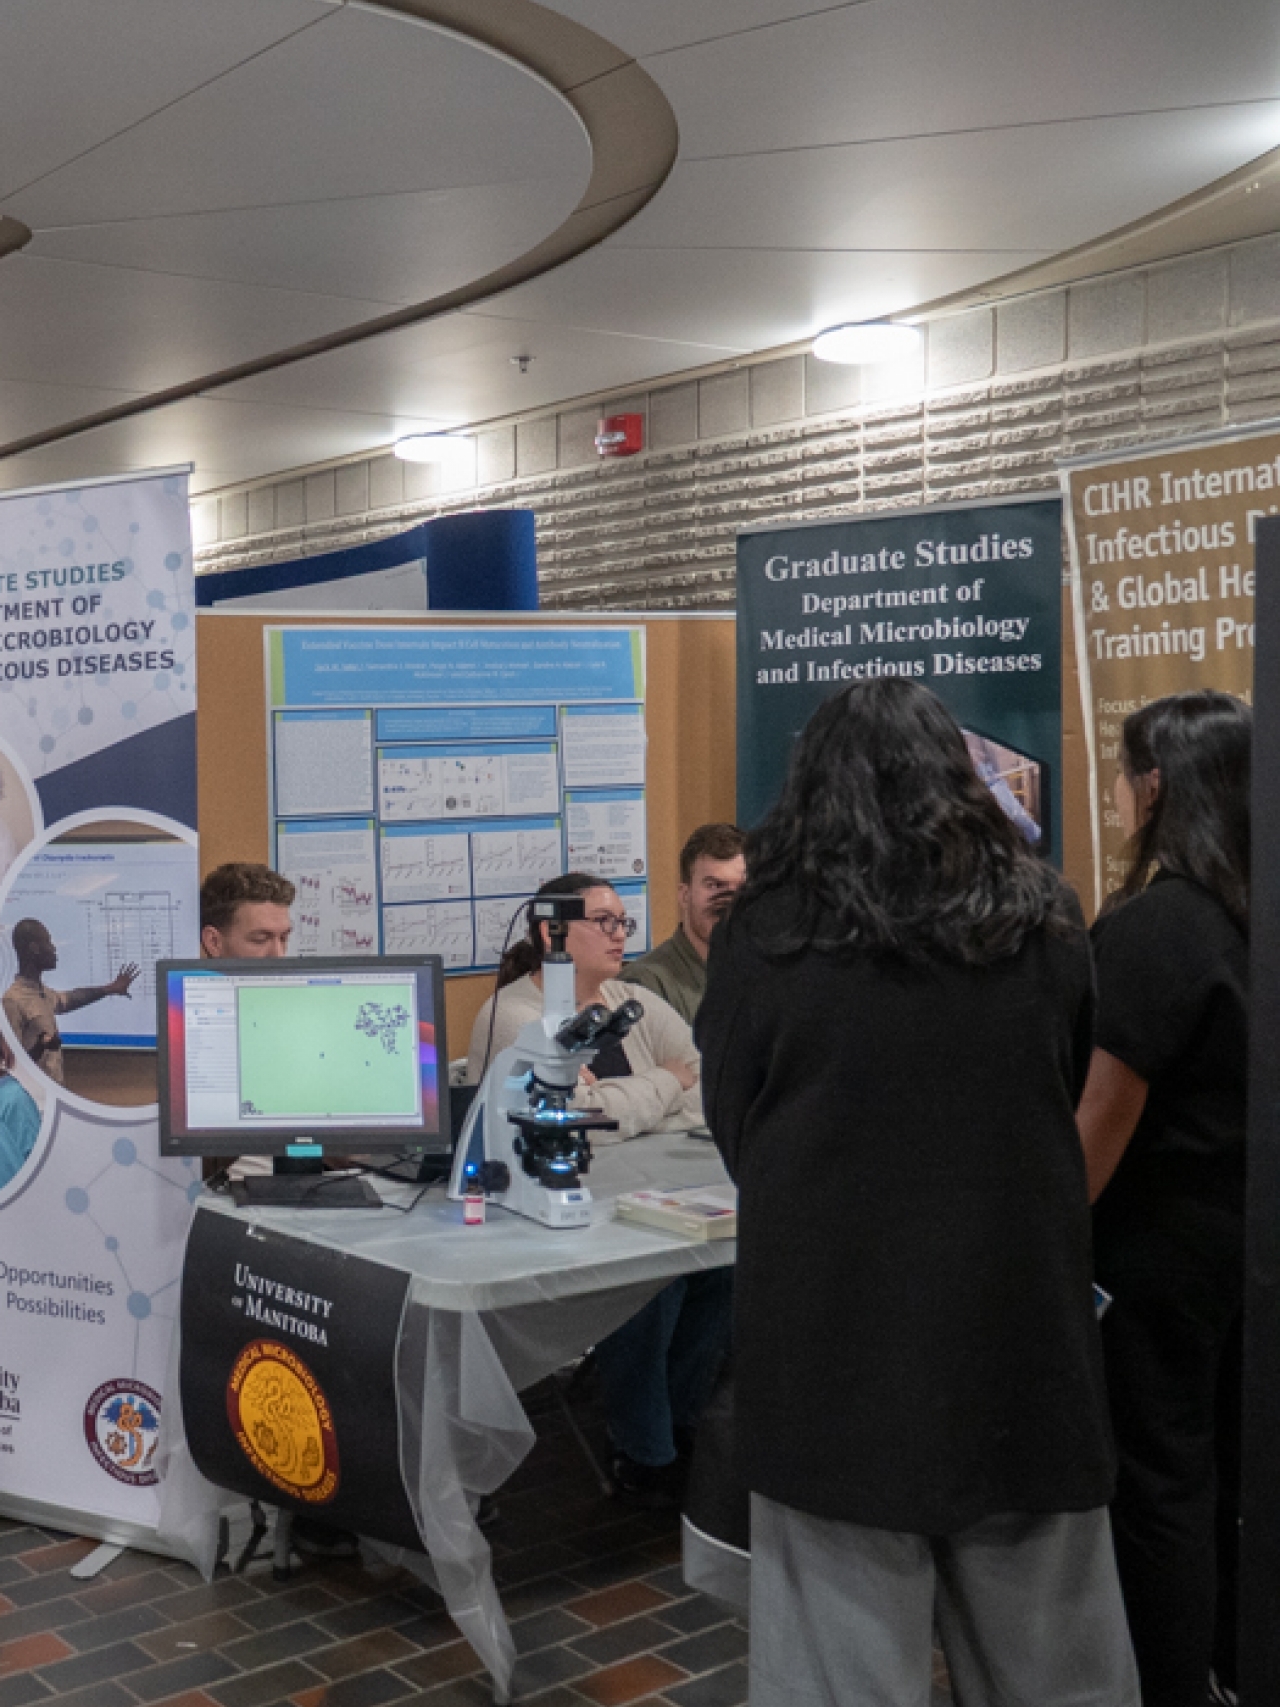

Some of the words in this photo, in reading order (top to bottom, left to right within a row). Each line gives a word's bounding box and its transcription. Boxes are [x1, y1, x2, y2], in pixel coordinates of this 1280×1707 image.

[1083, 475, 1152, 516] CIHR
[764, 547, 906, 581] Graduate
[914, 532, 1034, 568] Studies
[1085, 519, 1236, 565] Infectious
[26, 560, 126, 591] STUDIES
[1091, 580, 1110, 612] &
[1118, 566, 1210, 610] Global
[1219, 563, 1256, 599] He
[72, 594, 102, 616] OF
[802, 583, 949, 618] Department
[956, 578, 985, 602] of
[760, 624, 851, 651] Medical
[858, 615, 1030, 642] Microbiology
[1092, 620, 1206, 662] Training
[57, 650, 176, 677] DISEASES
[756, 661, 799, 684] and
[807, 656, 925, 682] Infectious
[931, 652, 1042, 676] Diseases
[6, 1290, 106, 1325] Possibilities
[0, 1424, 13, 1437] of
